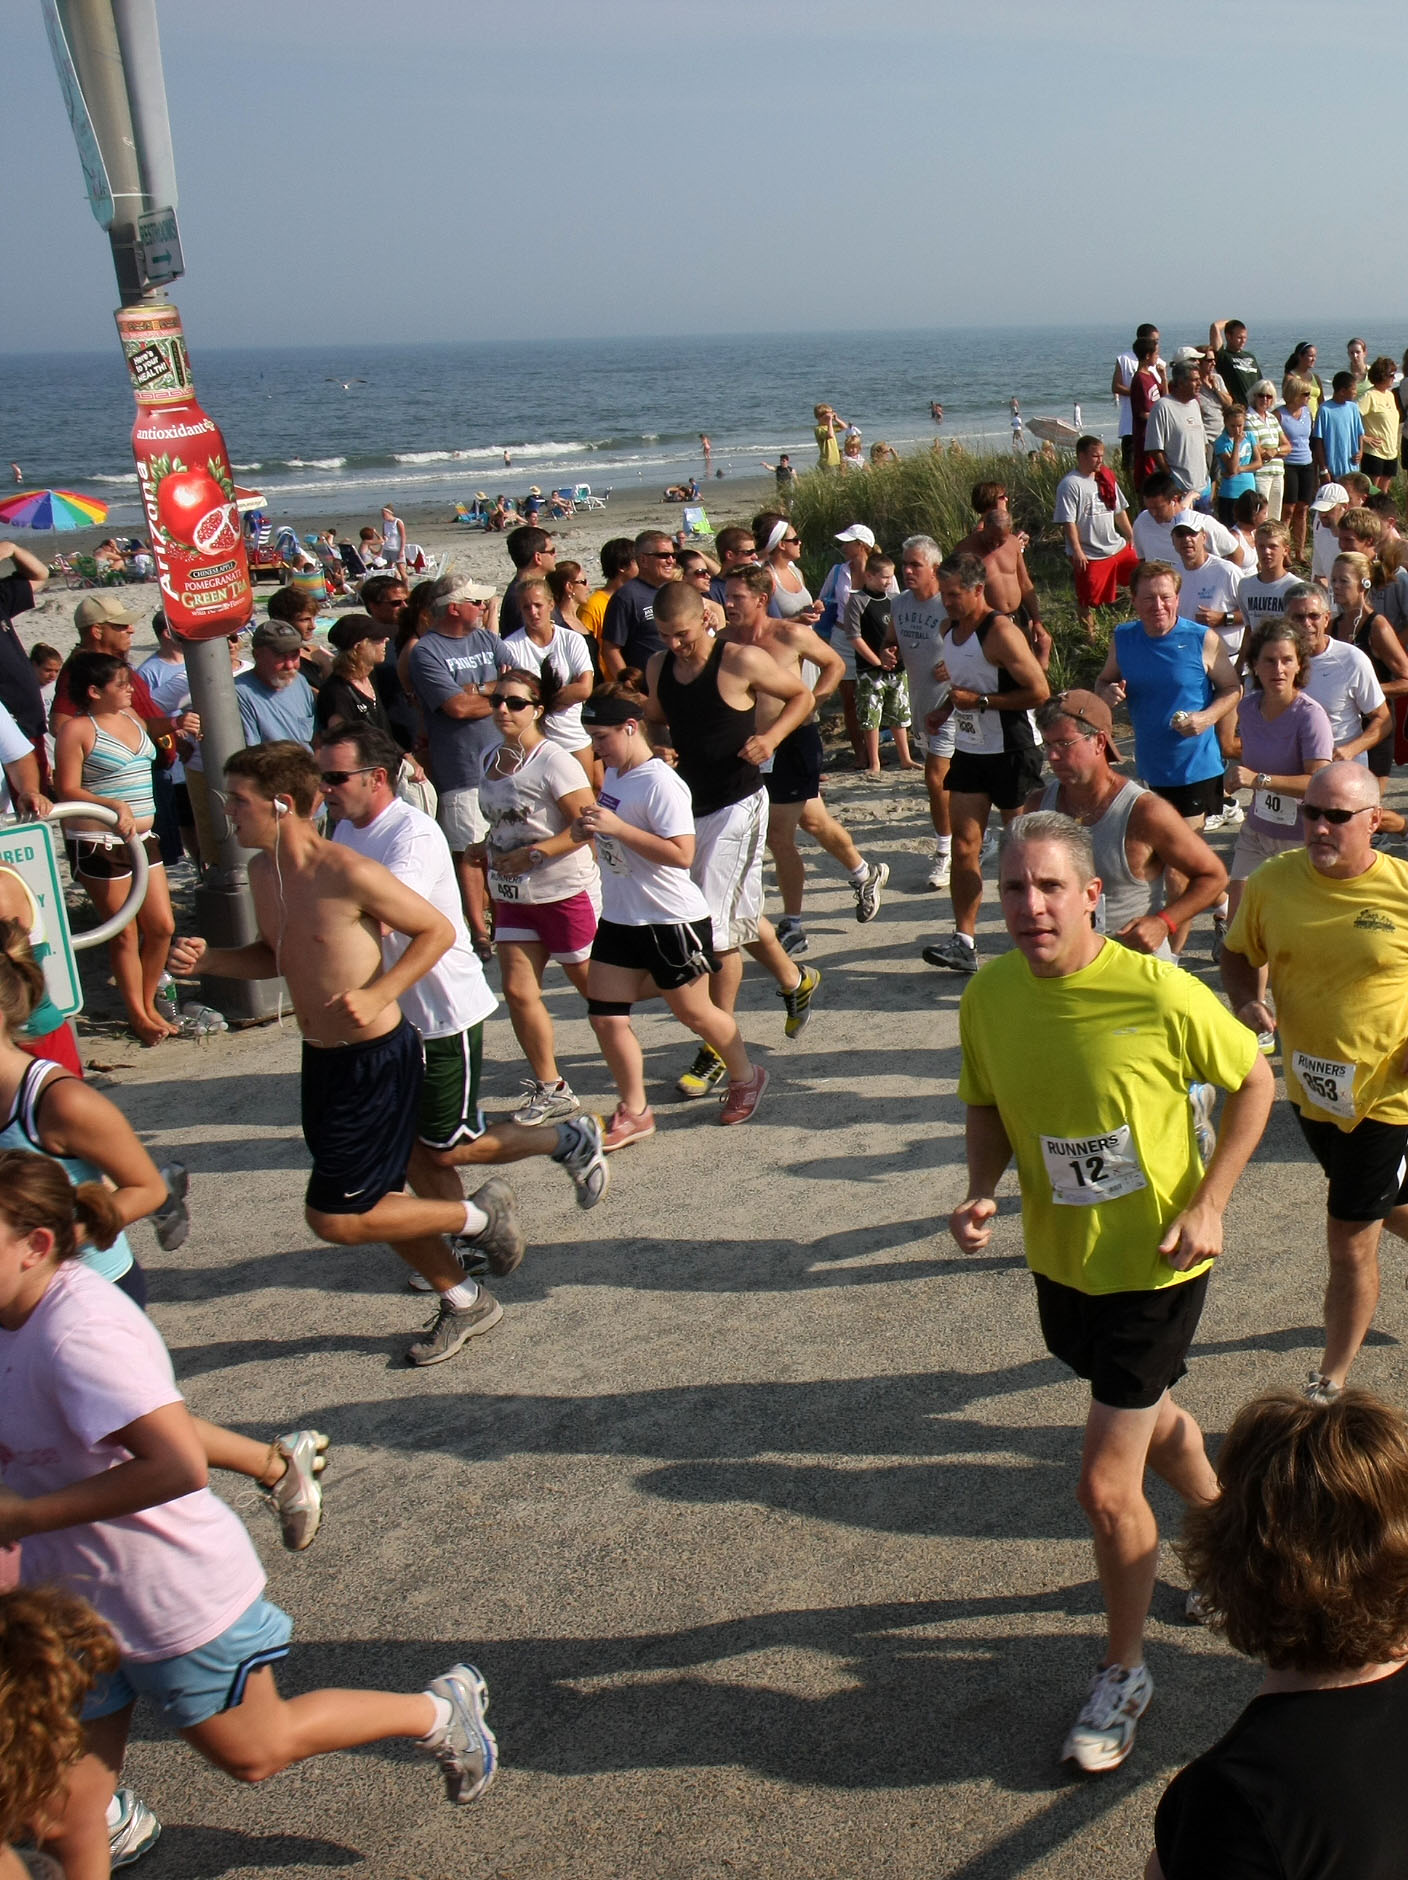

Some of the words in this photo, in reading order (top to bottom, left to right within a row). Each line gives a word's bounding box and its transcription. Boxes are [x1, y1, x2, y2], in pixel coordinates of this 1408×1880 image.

[143, 355, 159, 371] your
[184, 570, 242, 592] POMEGRANATE
[898, 612, 939, 629] EAGLES
[901, 629, 930, 640] FOOTBALL
[1264, 794, 1281, 812] 40
[497, 883, 519, 900] 487
[1298, 1054, 1347, 1077] RUNNERS
[1047, 1134, 1120, 1157] RUNNERS
[1068, 1156, 1110, 1188] 12
